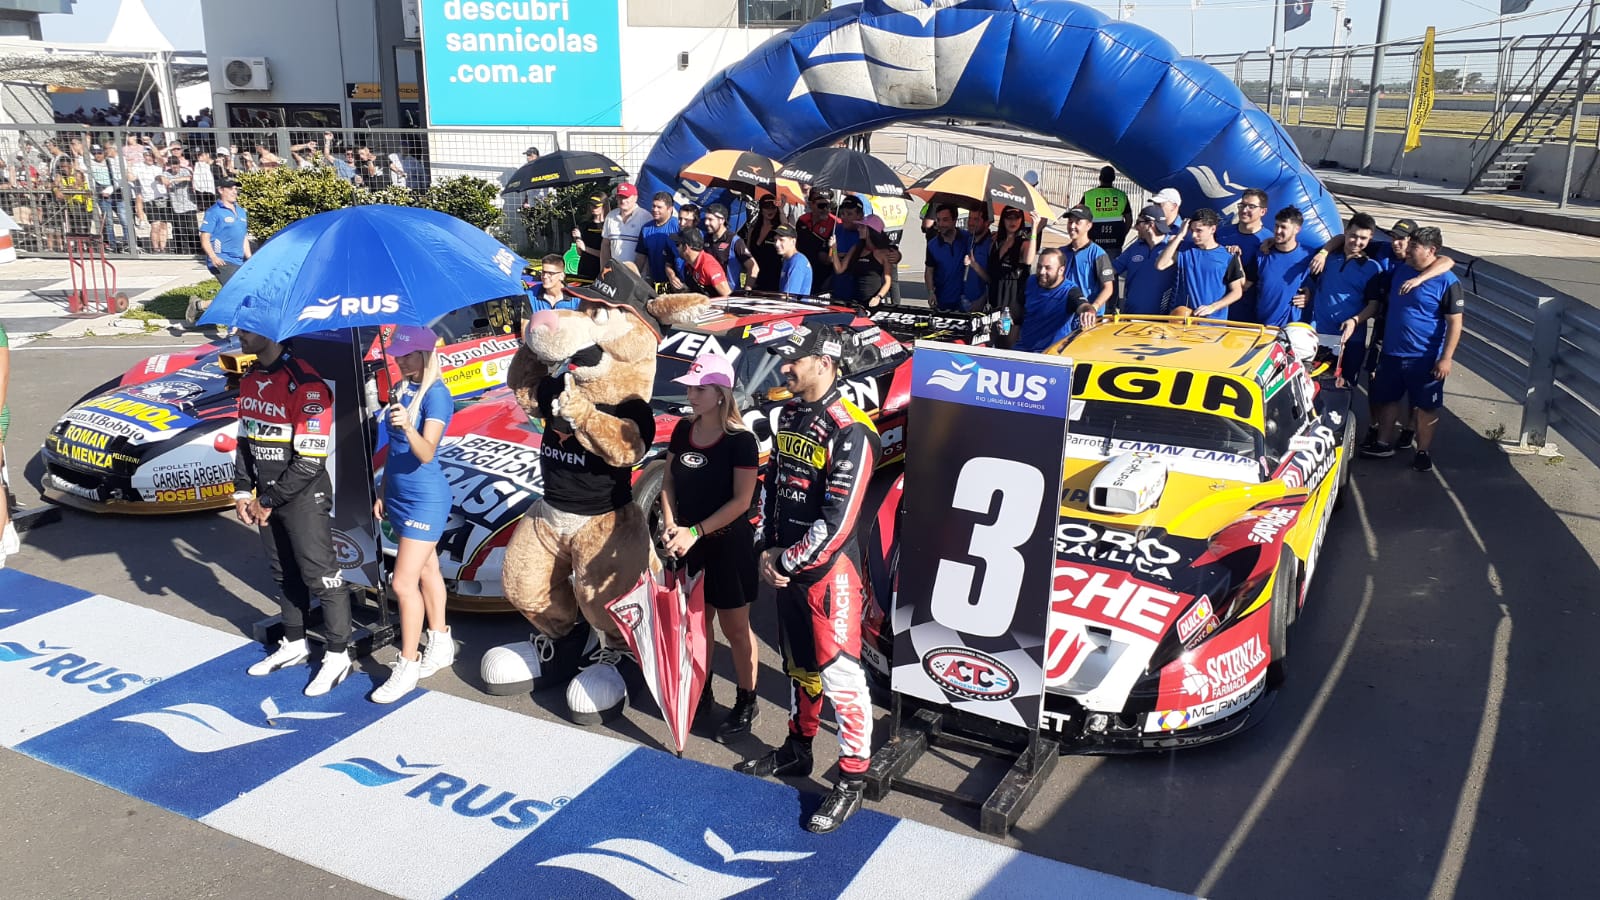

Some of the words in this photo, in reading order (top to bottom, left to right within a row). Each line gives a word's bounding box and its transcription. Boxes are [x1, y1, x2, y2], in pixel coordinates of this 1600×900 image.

[444, 0, 569, 21] descubri
[446, 27, 599, 53] sannicolas
[449, 63, 556, 84] .com.ar
[736, 169, 770, 185] CORVEN
[990, 188, 1026, 205] CORVEN
[1095, 196, 1119, 208] GPS
[340, 295, 400, 316] RUS
[976, 367, 1049, 403] RUS
[987, 396, 1016, 407] URUGUAY
[1017, 401, 1046, 411] SEGUROS
[64, 425, 111, 450] ROMAN
[56, 439, 70, 457] LA
[71, 445, 114, 469] MENZA
[1119, 441, 1185, 456] CAMAV
[153, 461, 202, 473] CIPOLLETTI
[153, 470, 192, 490] CARNES
[155, 487, 197, 502] JOSE
[930, 456, 1046, 638] 3
[1180, 601, 1211, 637] DULCOR
[1206, 632, 1267, 688] SCIENZA
[30, 652, 144, 695] RUS
[942, 659, 996, 688] ACTC
[1212, 675, 1248, 700] FARMACIA
[1192, 704, 1216, 719] MC
[404, 771, 556, 831] RUS
[810, 815, 834, 828] OMP
